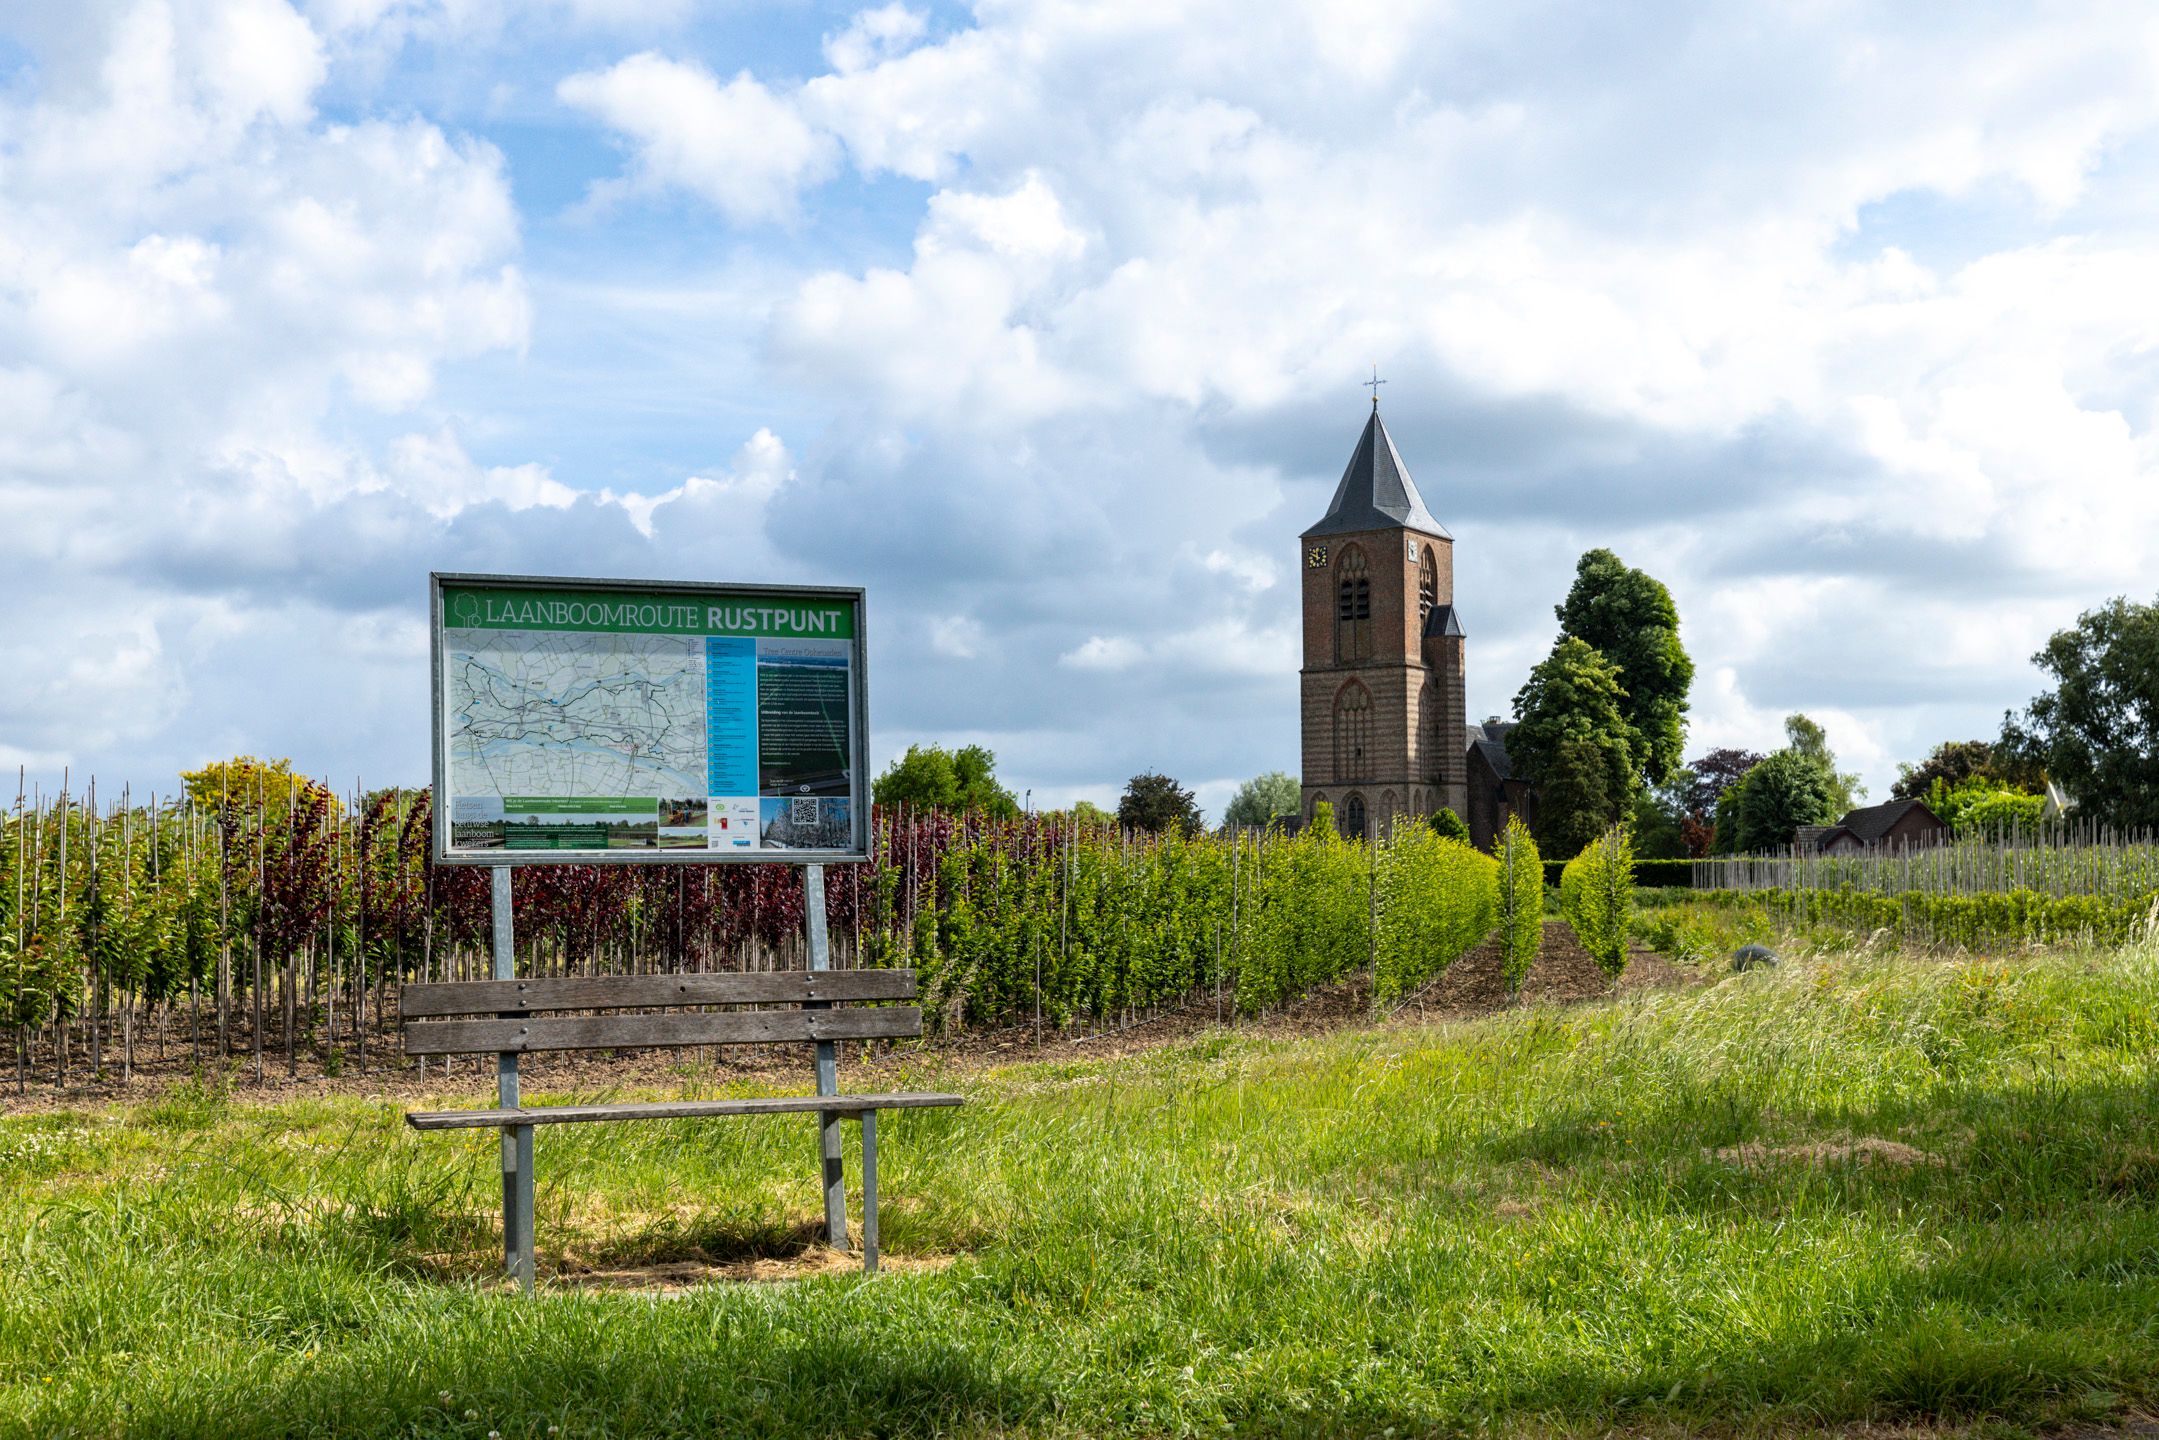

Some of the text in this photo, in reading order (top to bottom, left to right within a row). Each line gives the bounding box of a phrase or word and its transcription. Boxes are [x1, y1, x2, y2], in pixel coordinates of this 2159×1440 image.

[486, 599, 842, 632] LAANBOOMROUTE RUSTPUNT
[455, 838, 489, 847] kwekers
